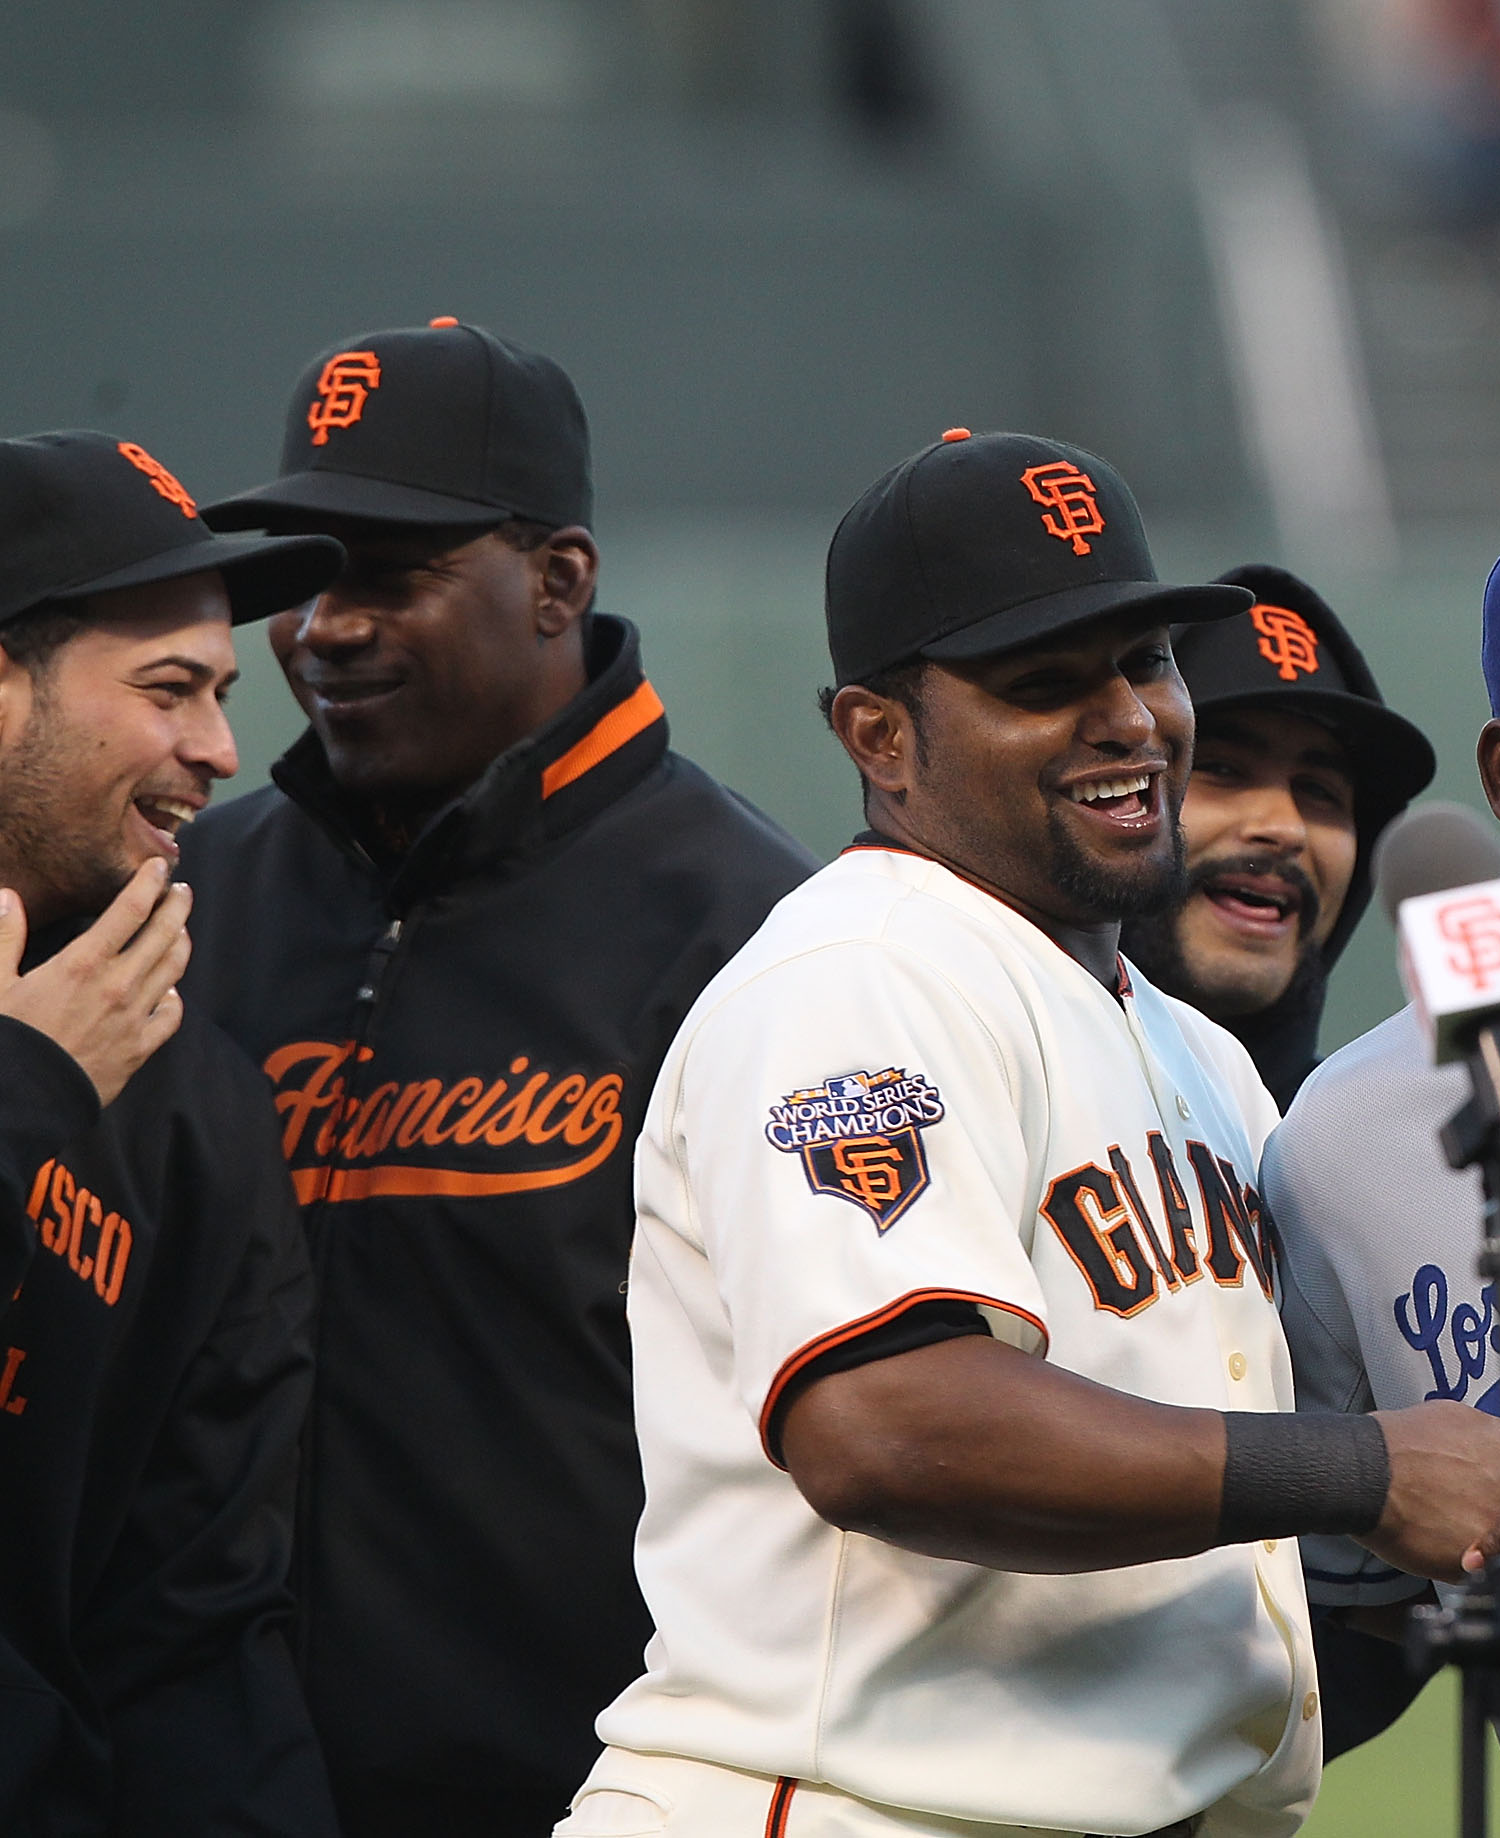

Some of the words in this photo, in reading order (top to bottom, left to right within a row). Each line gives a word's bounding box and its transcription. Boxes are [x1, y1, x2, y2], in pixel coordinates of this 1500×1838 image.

[307, 350, 381, 446] SF
[1020, 460, 1105, 556] SF
[1249, 603, 1319, 682] SF
[263, 1039, 625, 1161] Francisco
[766, 1088, 944, 1150] CHAMPIONS
[769, 1097, 861, 1126] WORLD
[862, 1075, 927, 1112] SERIES
[832, 1135, 904, 1210] SF
